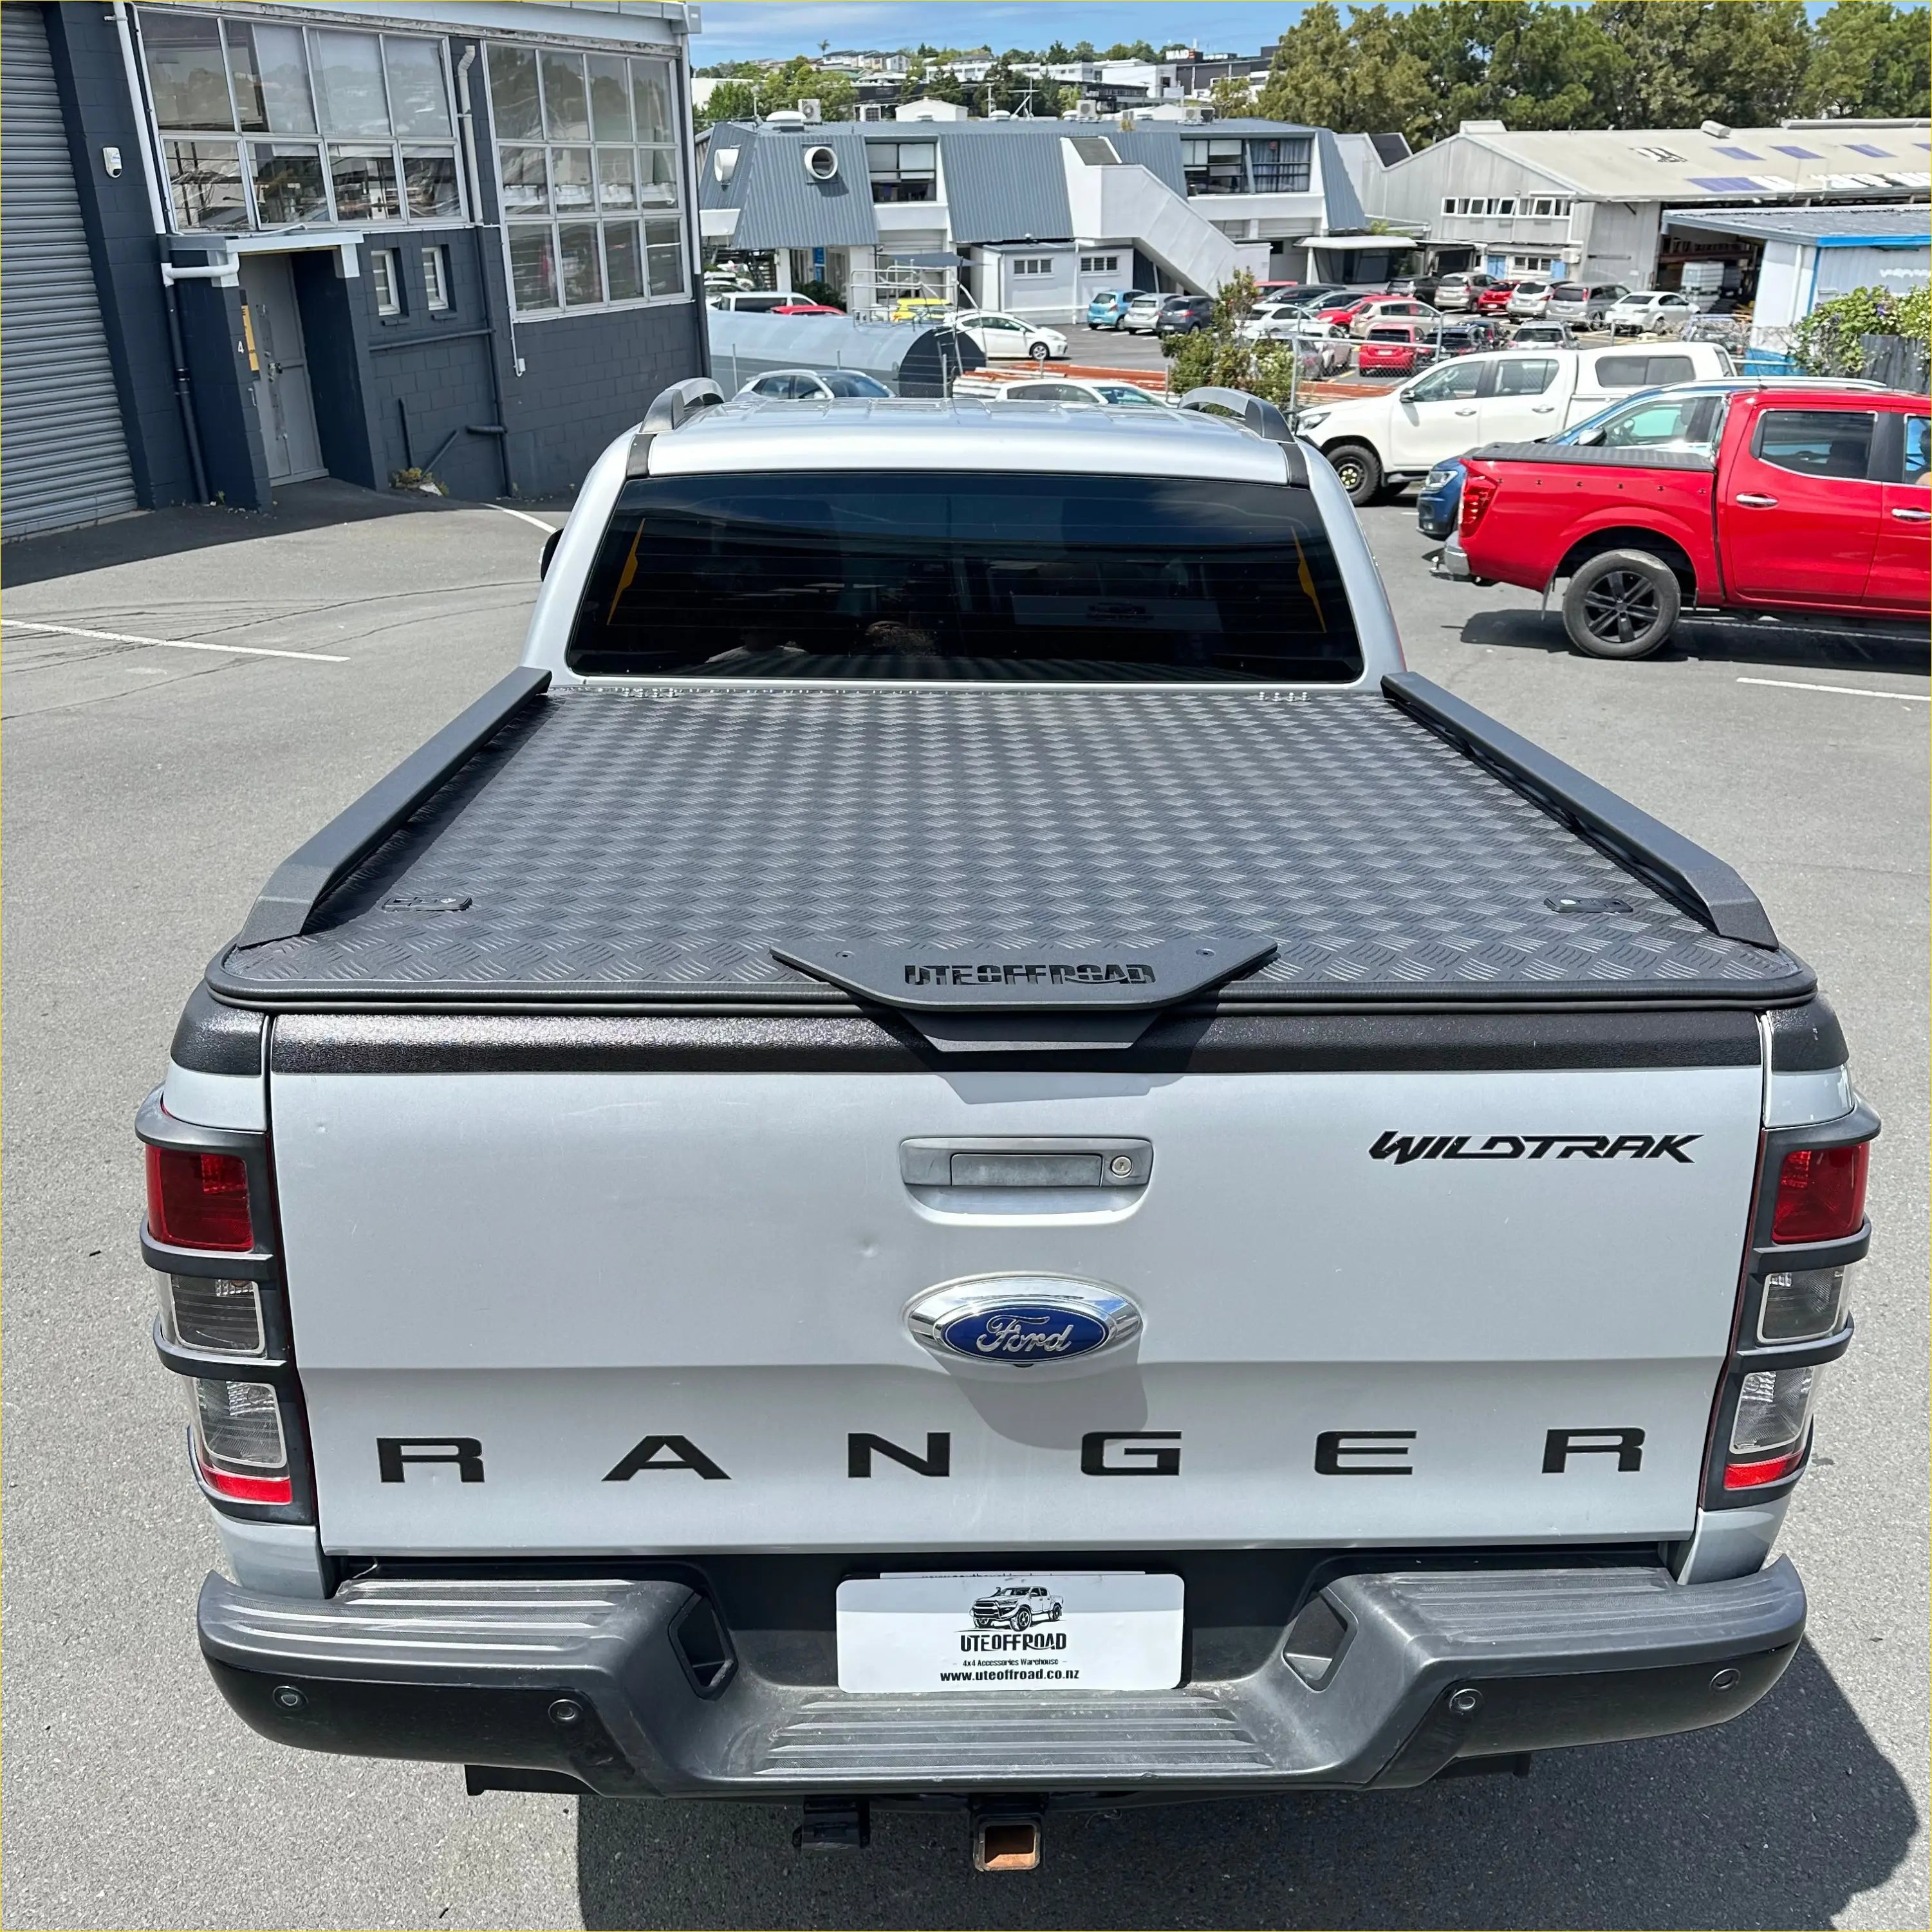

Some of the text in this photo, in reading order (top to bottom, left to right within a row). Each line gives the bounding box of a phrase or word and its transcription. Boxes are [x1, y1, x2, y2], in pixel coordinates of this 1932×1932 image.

[237, 340, 245, 353] 4
[904, 965, 1153, 986] UTEOFFROAD
[1368, 1130, 1705, 1164] WILDTRAK
[976, 1314, 1074, 1352] Ford
[376, 1427, 1645, 1483] RANGER
[960, 1633, 1067, 1652] UTEOFFROAD
[940, 1669, 1080, 1682] www.uteoffroad.co.nz
